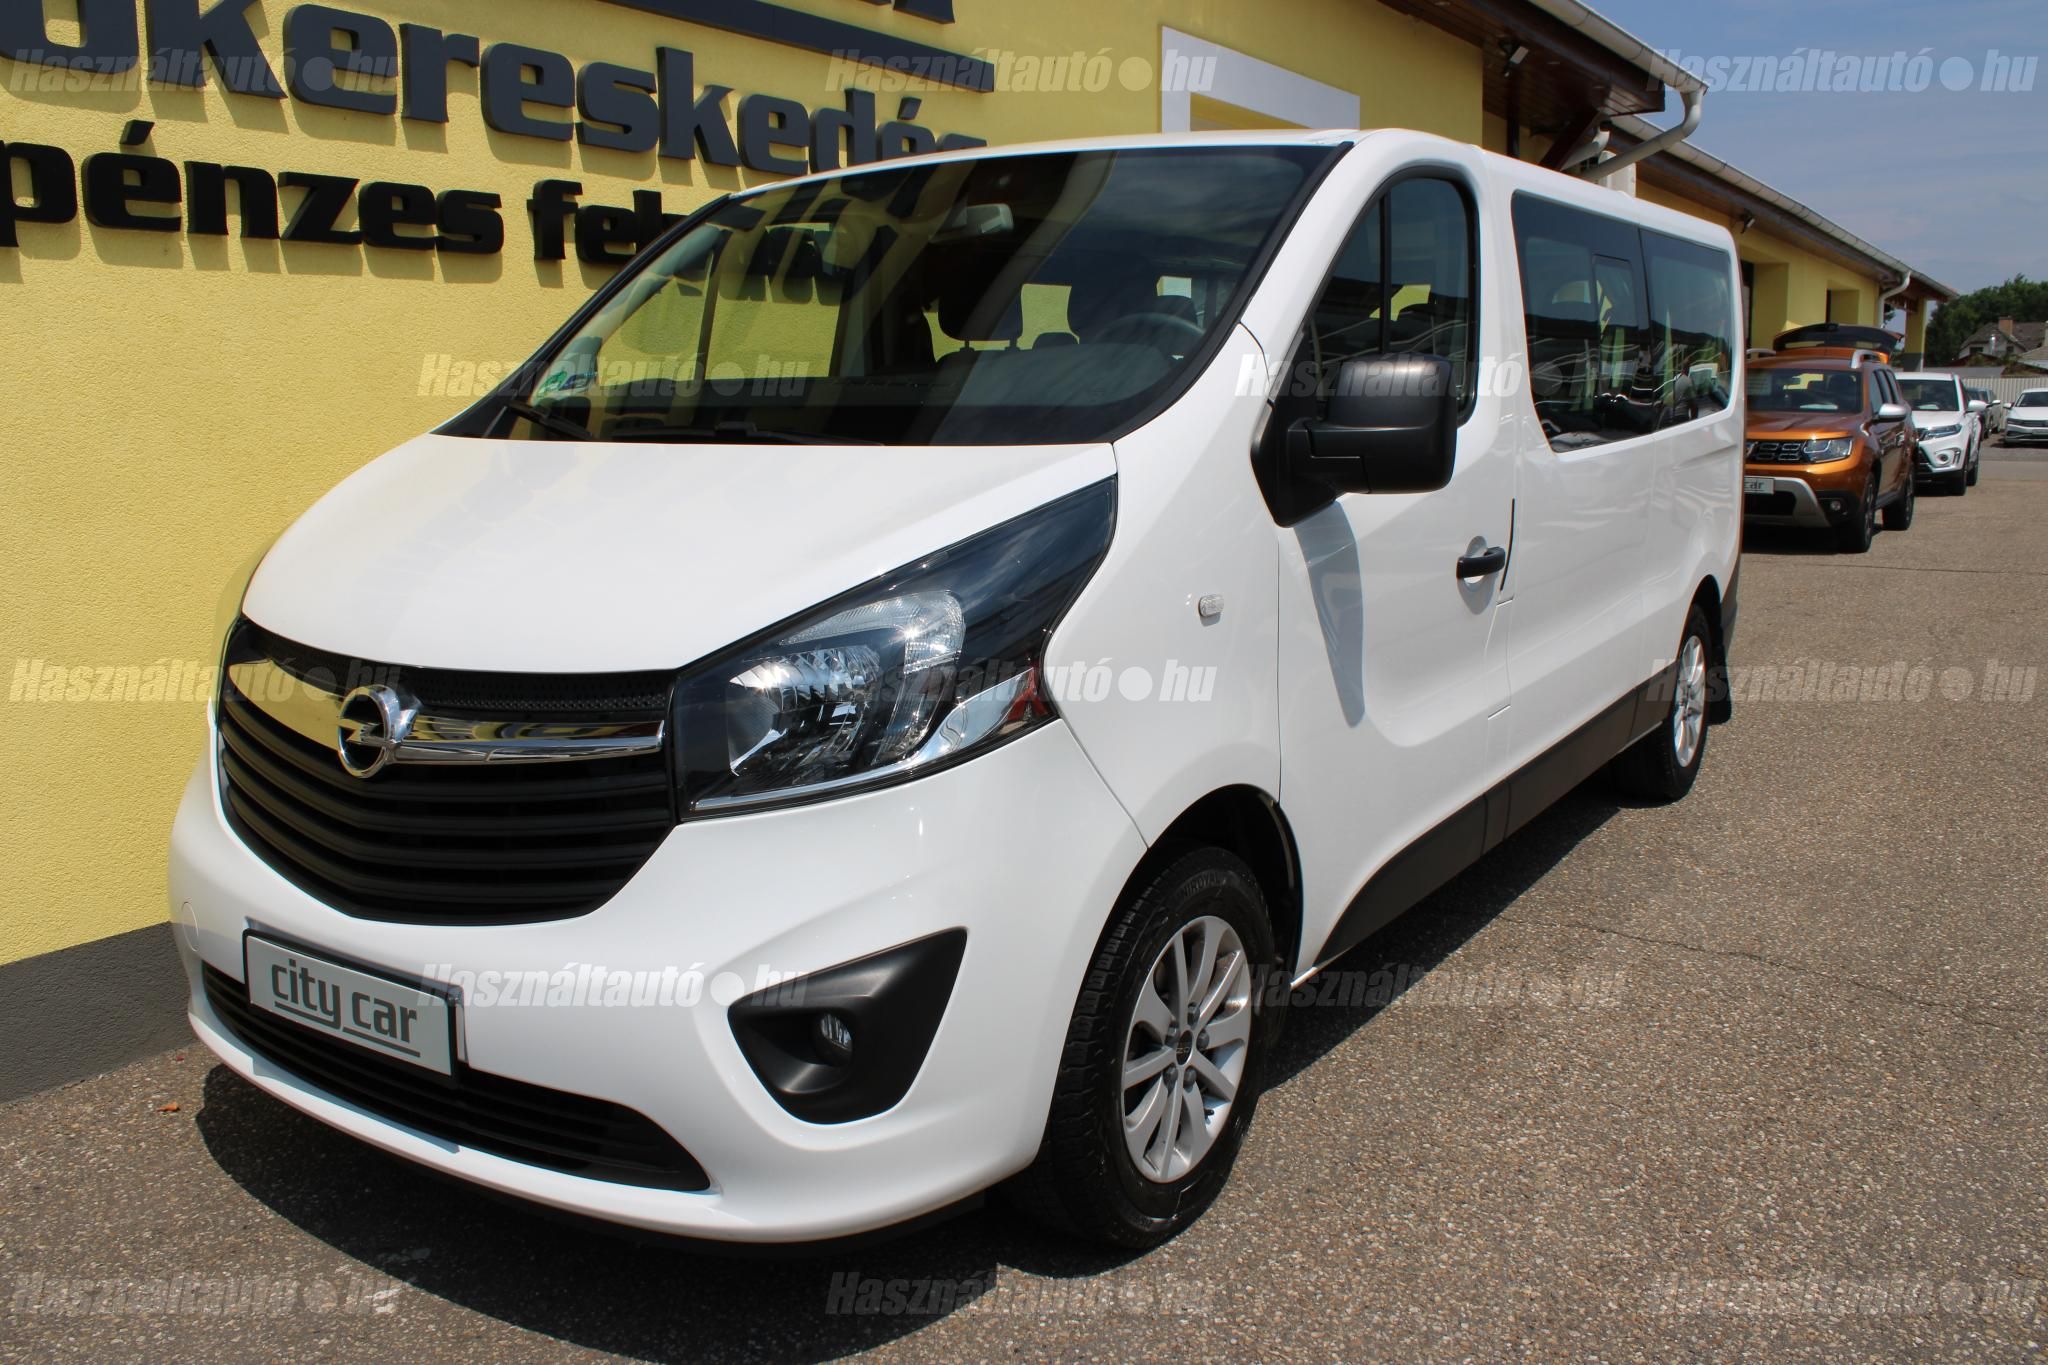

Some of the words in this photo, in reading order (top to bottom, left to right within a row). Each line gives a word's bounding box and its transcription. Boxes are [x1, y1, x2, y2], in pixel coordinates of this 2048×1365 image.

[0, 119, 504, 255] pénzes
[526, 179, 693, 264] fel
[271, 958, 341, 1030] city
[352, 991, 418, 1044] car
